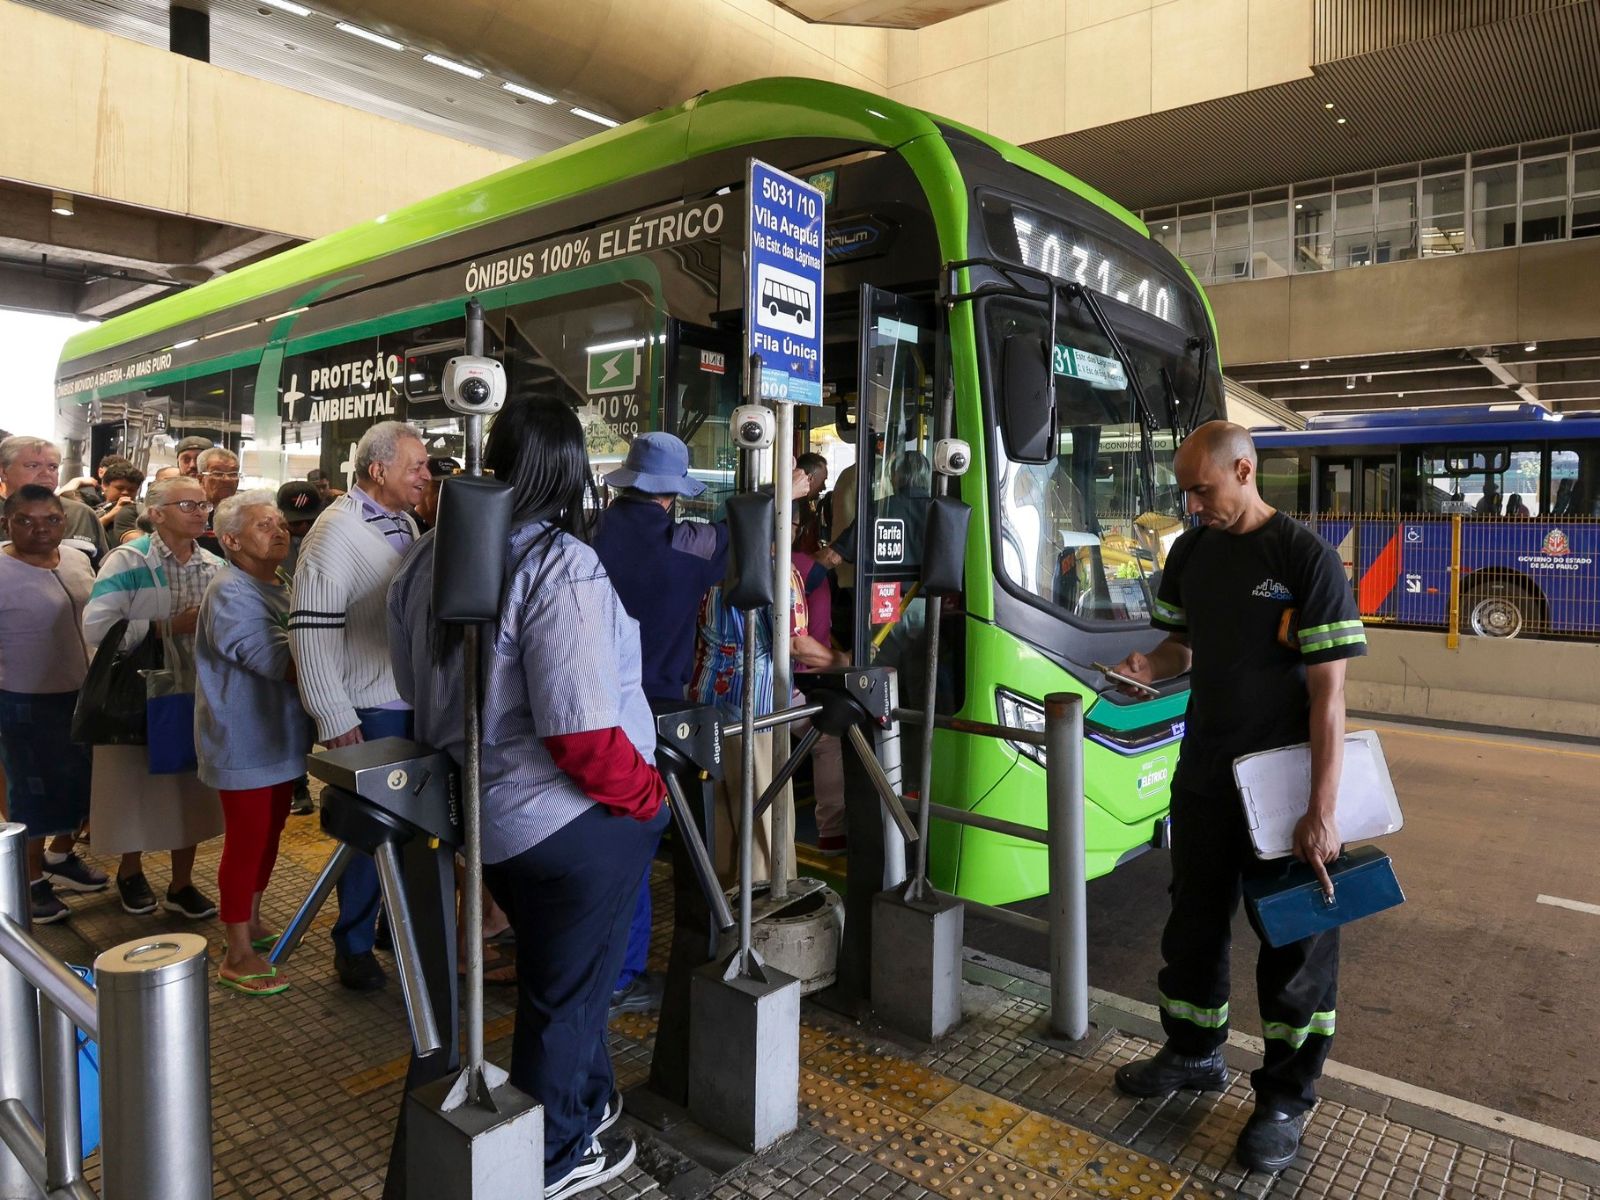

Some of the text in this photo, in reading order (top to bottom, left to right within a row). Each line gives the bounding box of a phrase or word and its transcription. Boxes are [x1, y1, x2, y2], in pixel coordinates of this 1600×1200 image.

[762, 177, 816, 219] 5031 /10
[754, 204, 819, 249] Vila Arapuá
[465, 203, 725, 293] ÔNIBUS 100% ELÉTRICO
[753, 230, 821, 270] Via Estr. das Lágrimas
[754, 331, 818, 361] Fila Única
[1054, 345, 1073, 375] 31
[94, 374, 99, 388] A
[99, 367, 123, 386] BATERIA
[126, 363, 136, 379] AR
[136, 359, 152, 377] MAIS
[152, 353, 172, 372] PURO
[310, 352, 399, 392] PROTEÇÃO
[308, 390, 396, 423] AMBIENTAL
[877, 542, 901, 558] R$ 5,00
[878, 525, 902, 540] Tarifa
[713, 721, 721, 764] digicon
[391, 771, 403, 787] 3
